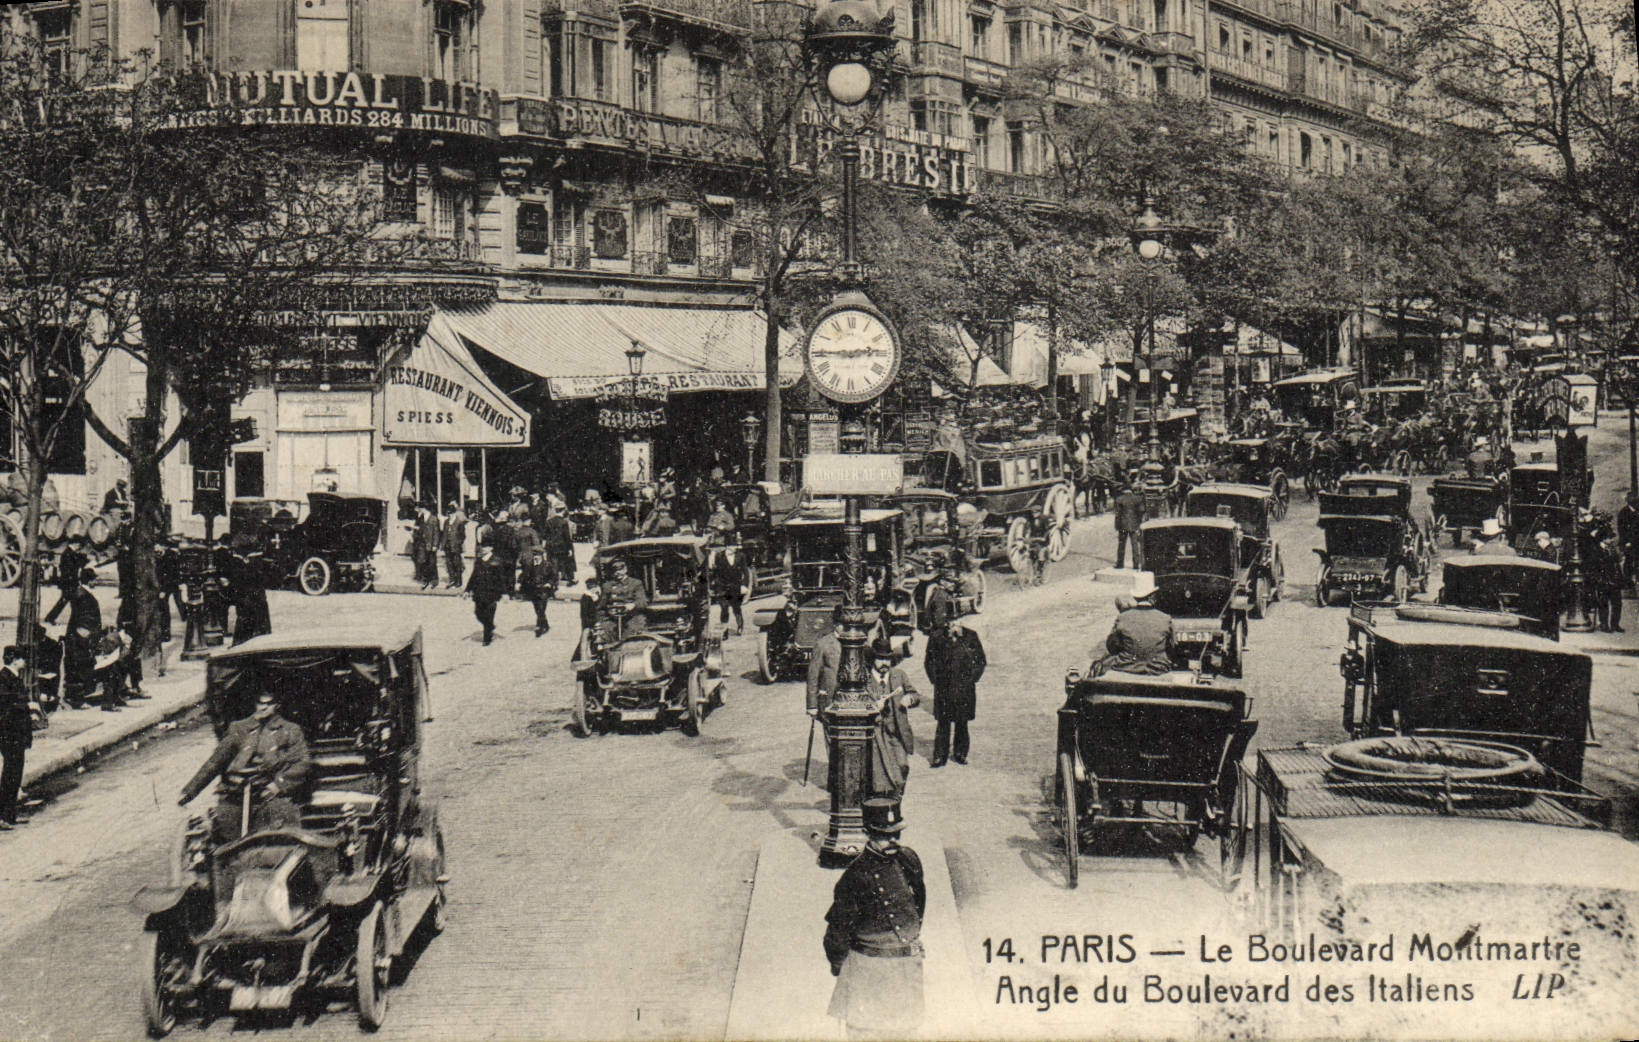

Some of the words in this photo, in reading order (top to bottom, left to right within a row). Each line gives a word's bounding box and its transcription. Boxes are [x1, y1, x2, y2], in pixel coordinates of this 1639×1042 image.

[206, 70, 399, 110] MUTUAL
[421, 77, 493, 120] LIFE
[366, 111, 404, 128] 284
[410, 113, 488, 136] MILLIONS
[859, 144, 978, 195] BRESIL
[357, 311, 431, 327] VIENNOIS
[668, 373, 759, 389] RESTAURANT
[390, 366, 464, 402] RESTAURANT
[464, 390, 514, 435] VIENNOIS
[397, 411, 454, 424] SPIESS
[880, 467, 899, 481] PAS
